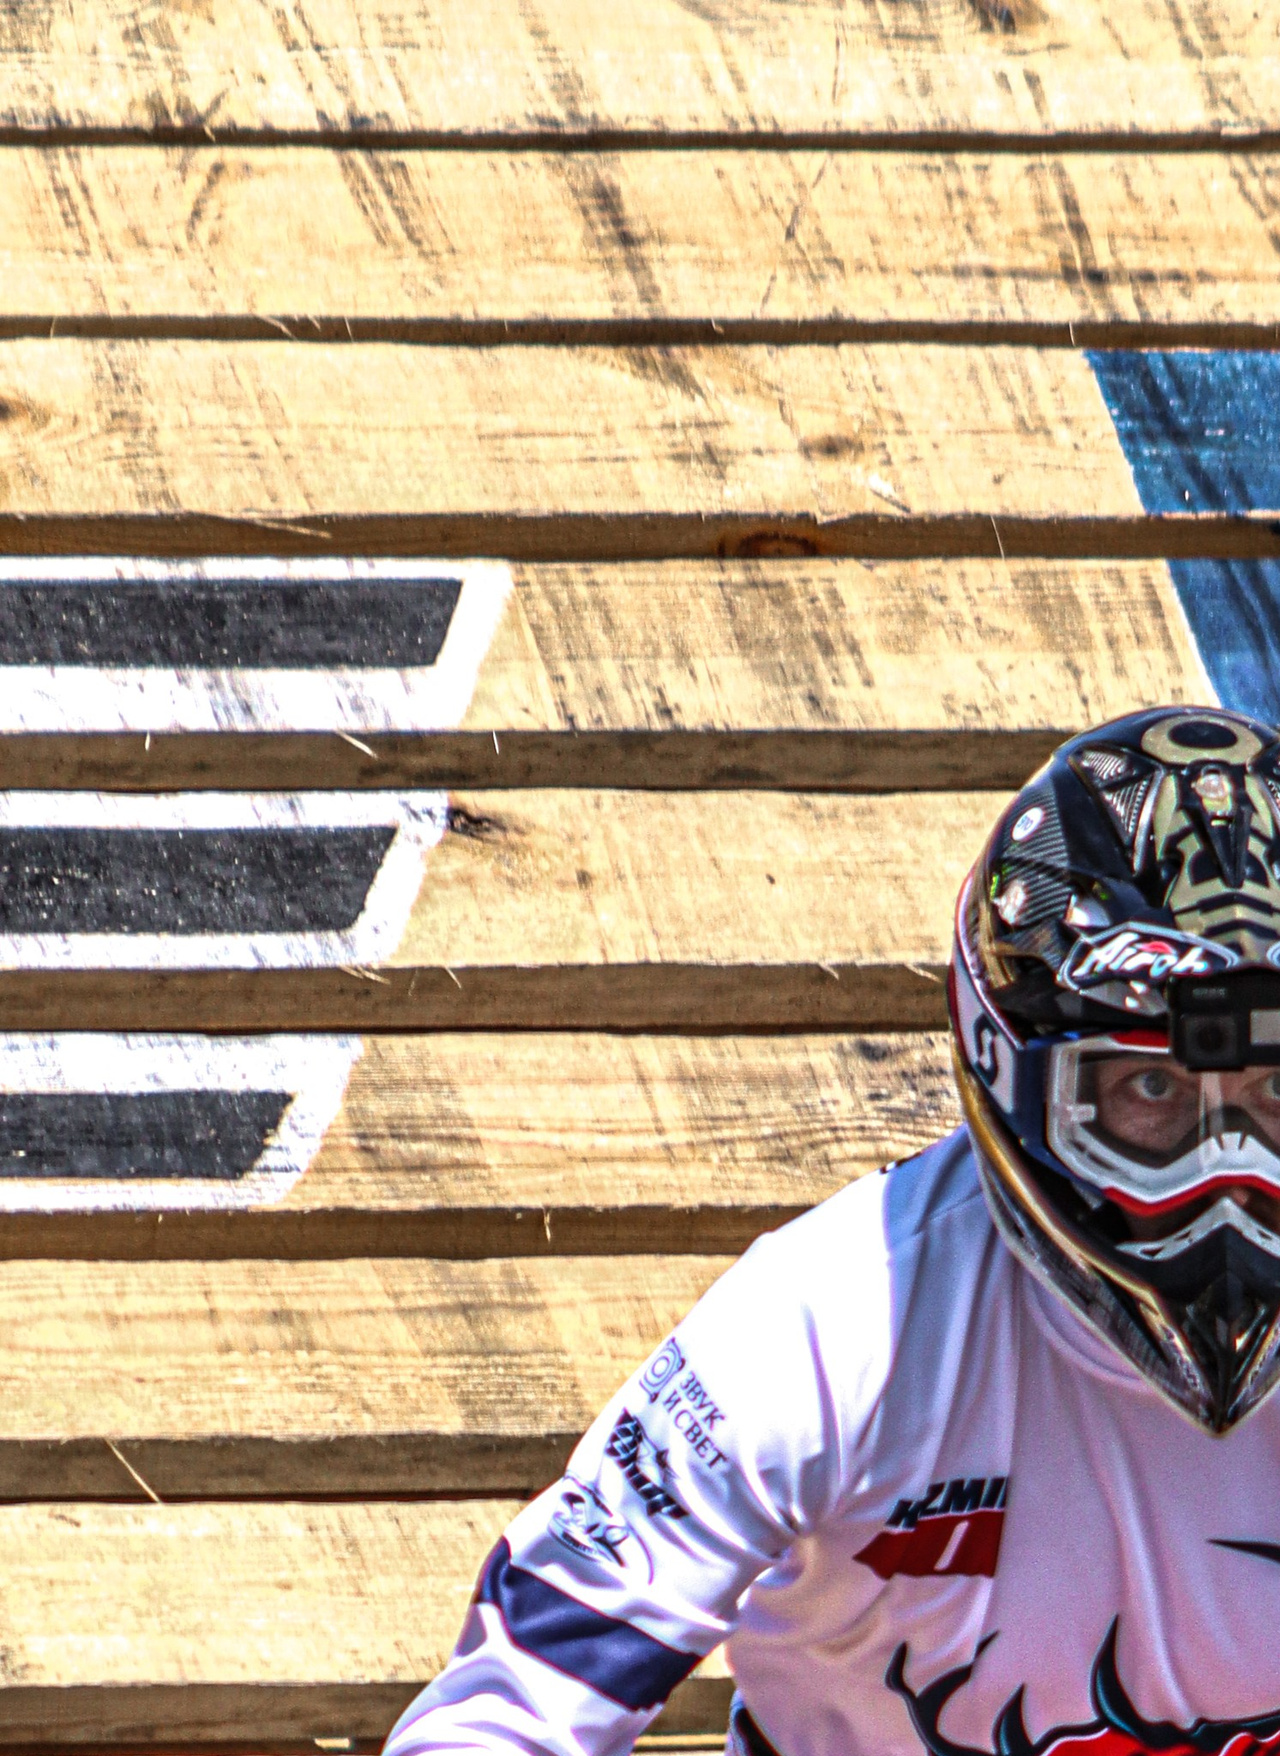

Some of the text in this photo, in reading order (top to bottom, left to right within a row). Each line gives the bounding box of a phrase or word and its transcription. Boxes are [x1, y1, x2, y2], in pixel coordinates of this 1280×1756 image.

[663, 1389, 730, 1469] И СВЕТ
[679, 1370, 726, 1432] ЗВУК
